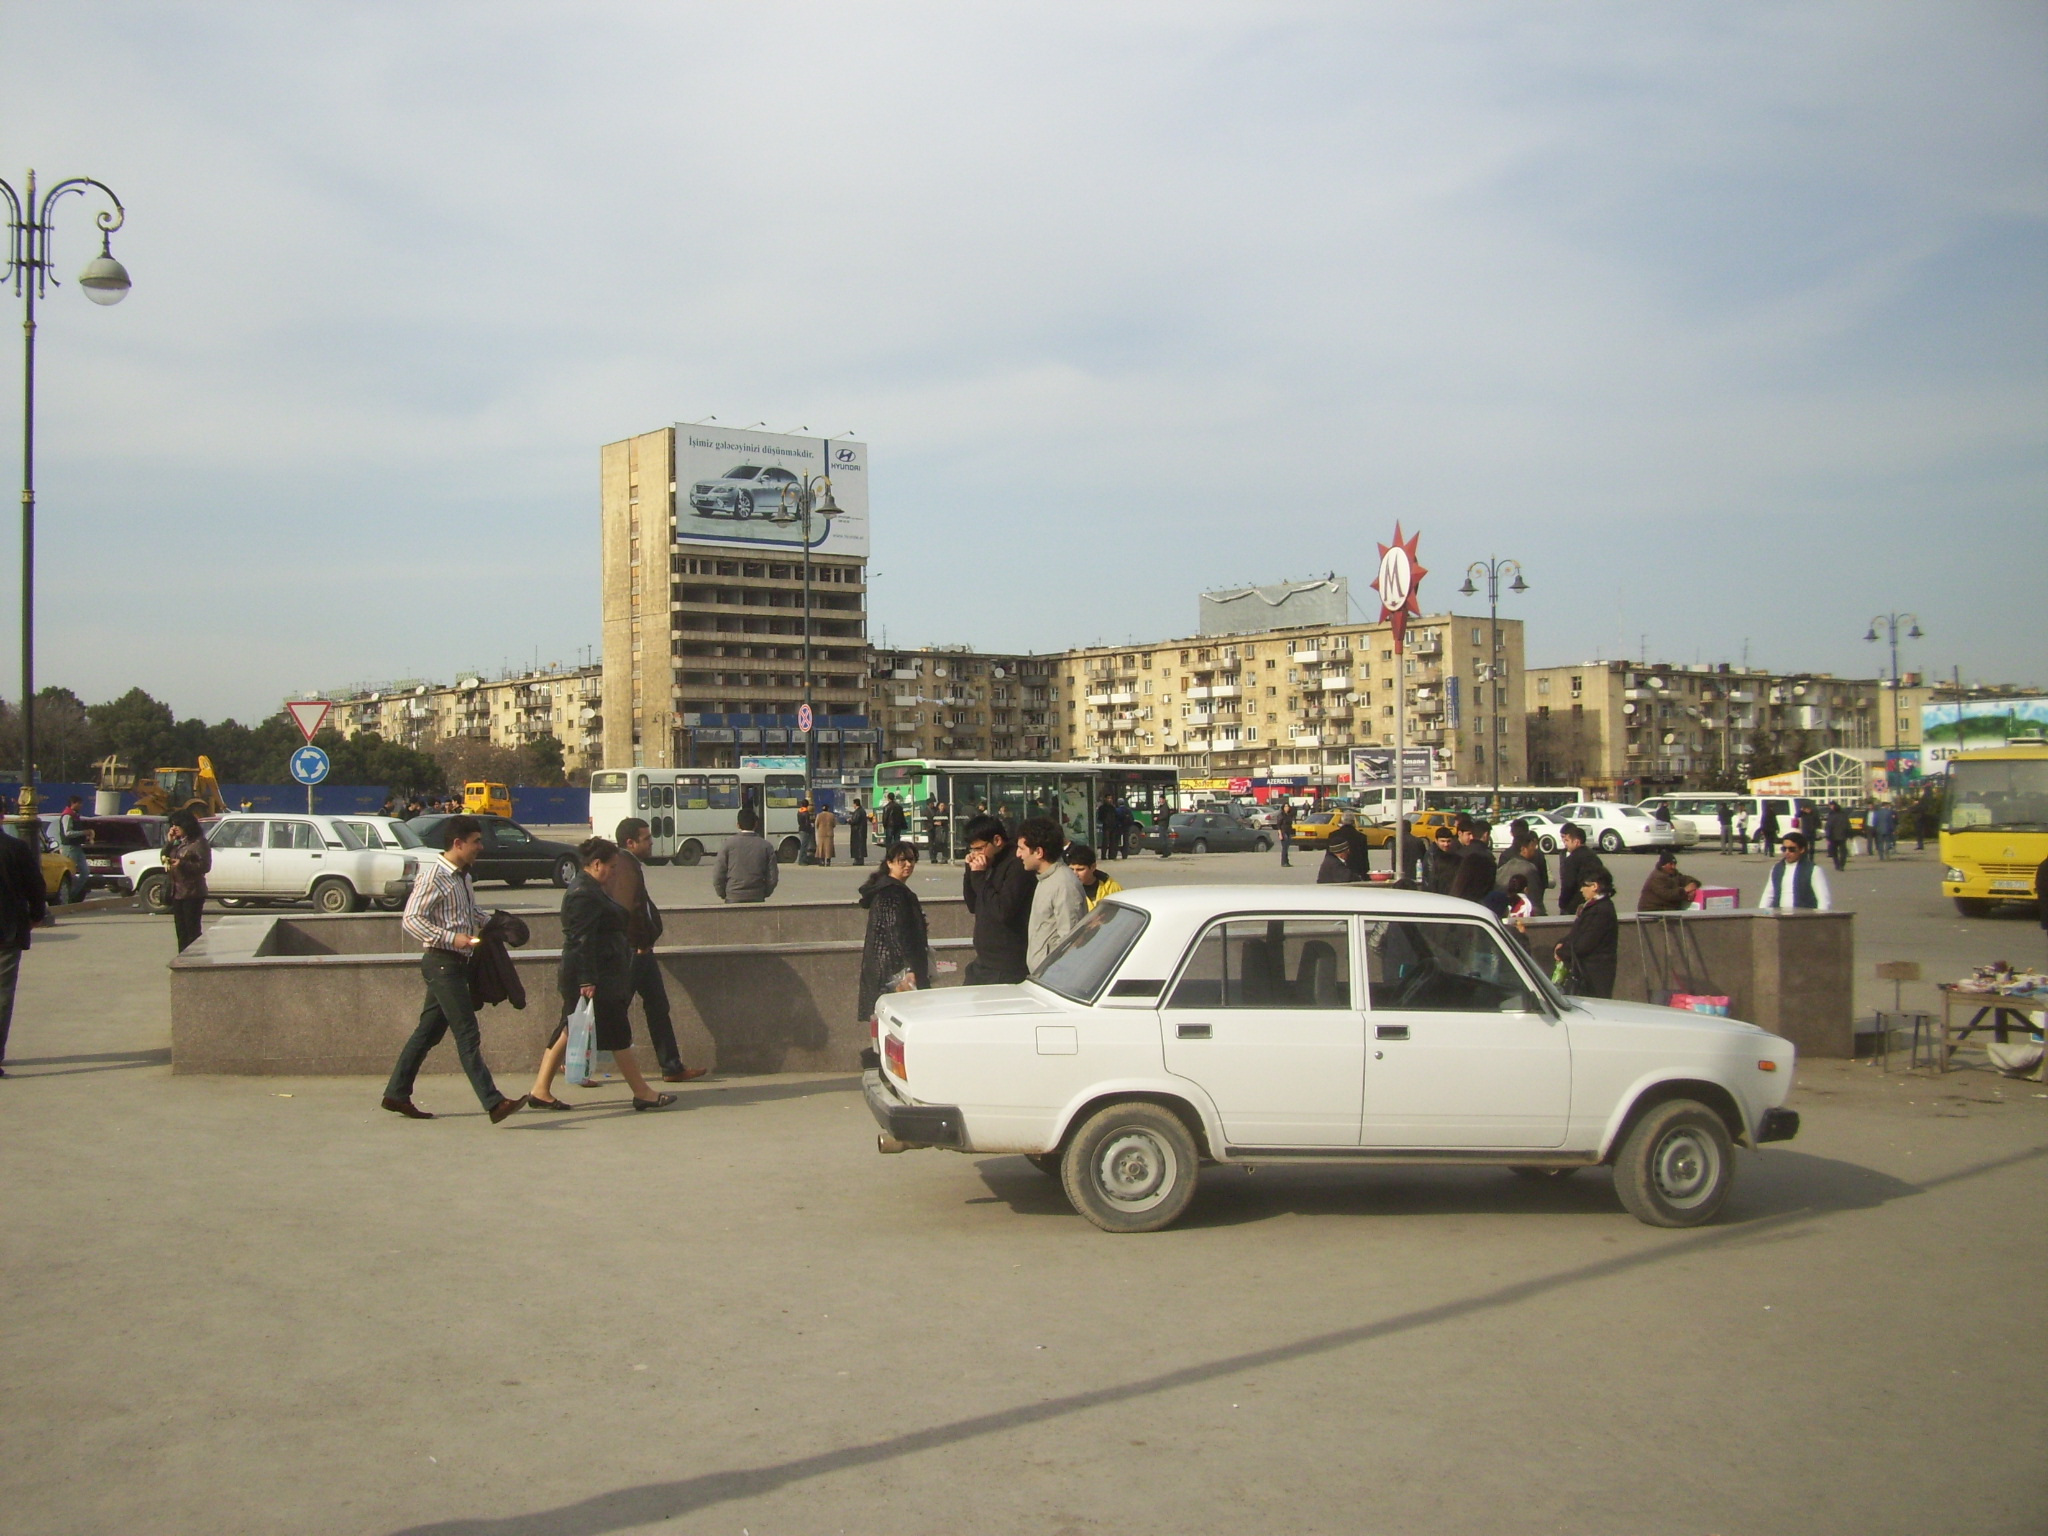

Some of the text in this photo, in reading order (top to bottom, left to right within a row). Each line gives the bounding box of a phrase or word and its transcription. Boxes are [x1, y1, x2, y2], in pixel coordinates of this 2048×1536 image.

[689, 435, 814, 459] İşimiz gələcəyinizi düşünməkdir.
[831, 463, 861, 472] HYUNDAI
[1384, 553, 1405, 601] M
